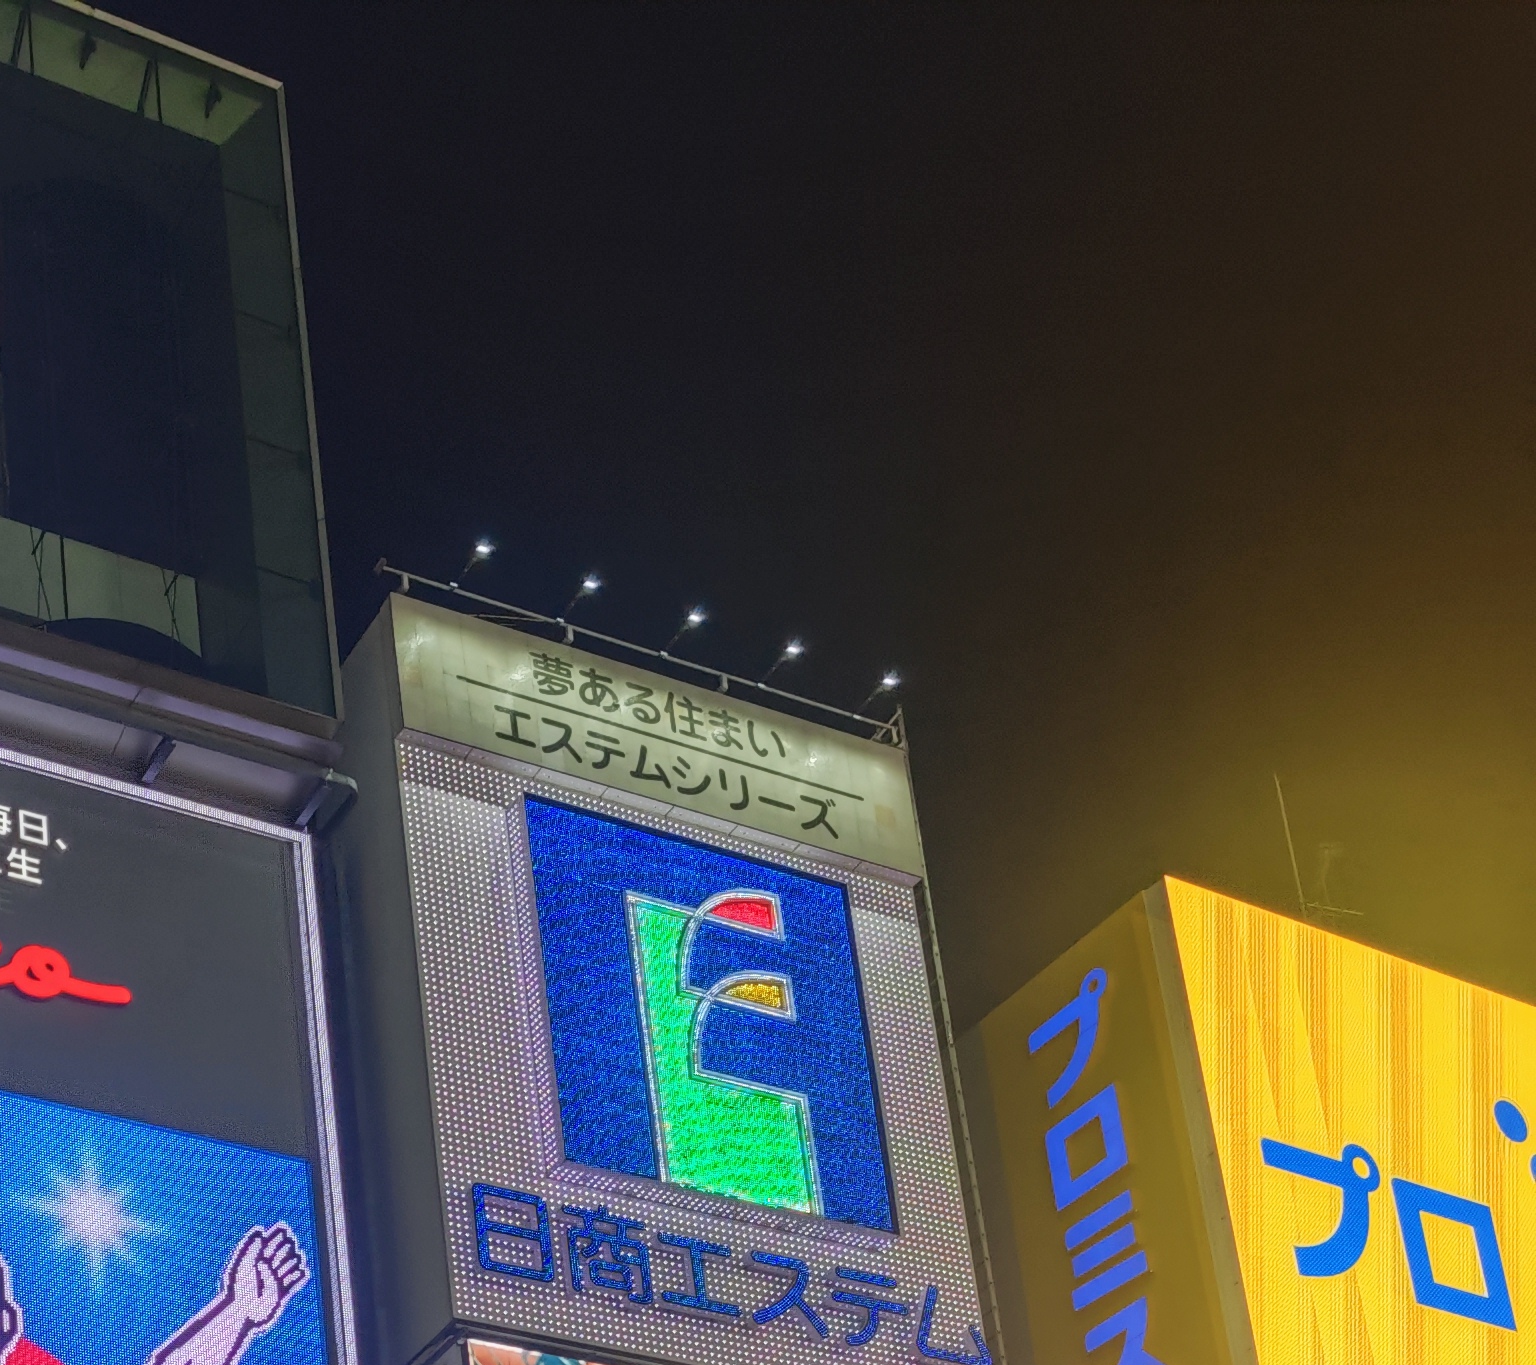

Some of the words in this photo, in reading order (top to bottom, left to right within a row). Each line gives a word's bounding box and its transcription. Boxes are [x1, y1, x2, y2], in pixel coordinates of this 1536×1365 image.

[528, 650, 788, 761] 夢ある住まい
[494, 703, 841, 841] エステムシリーズ
